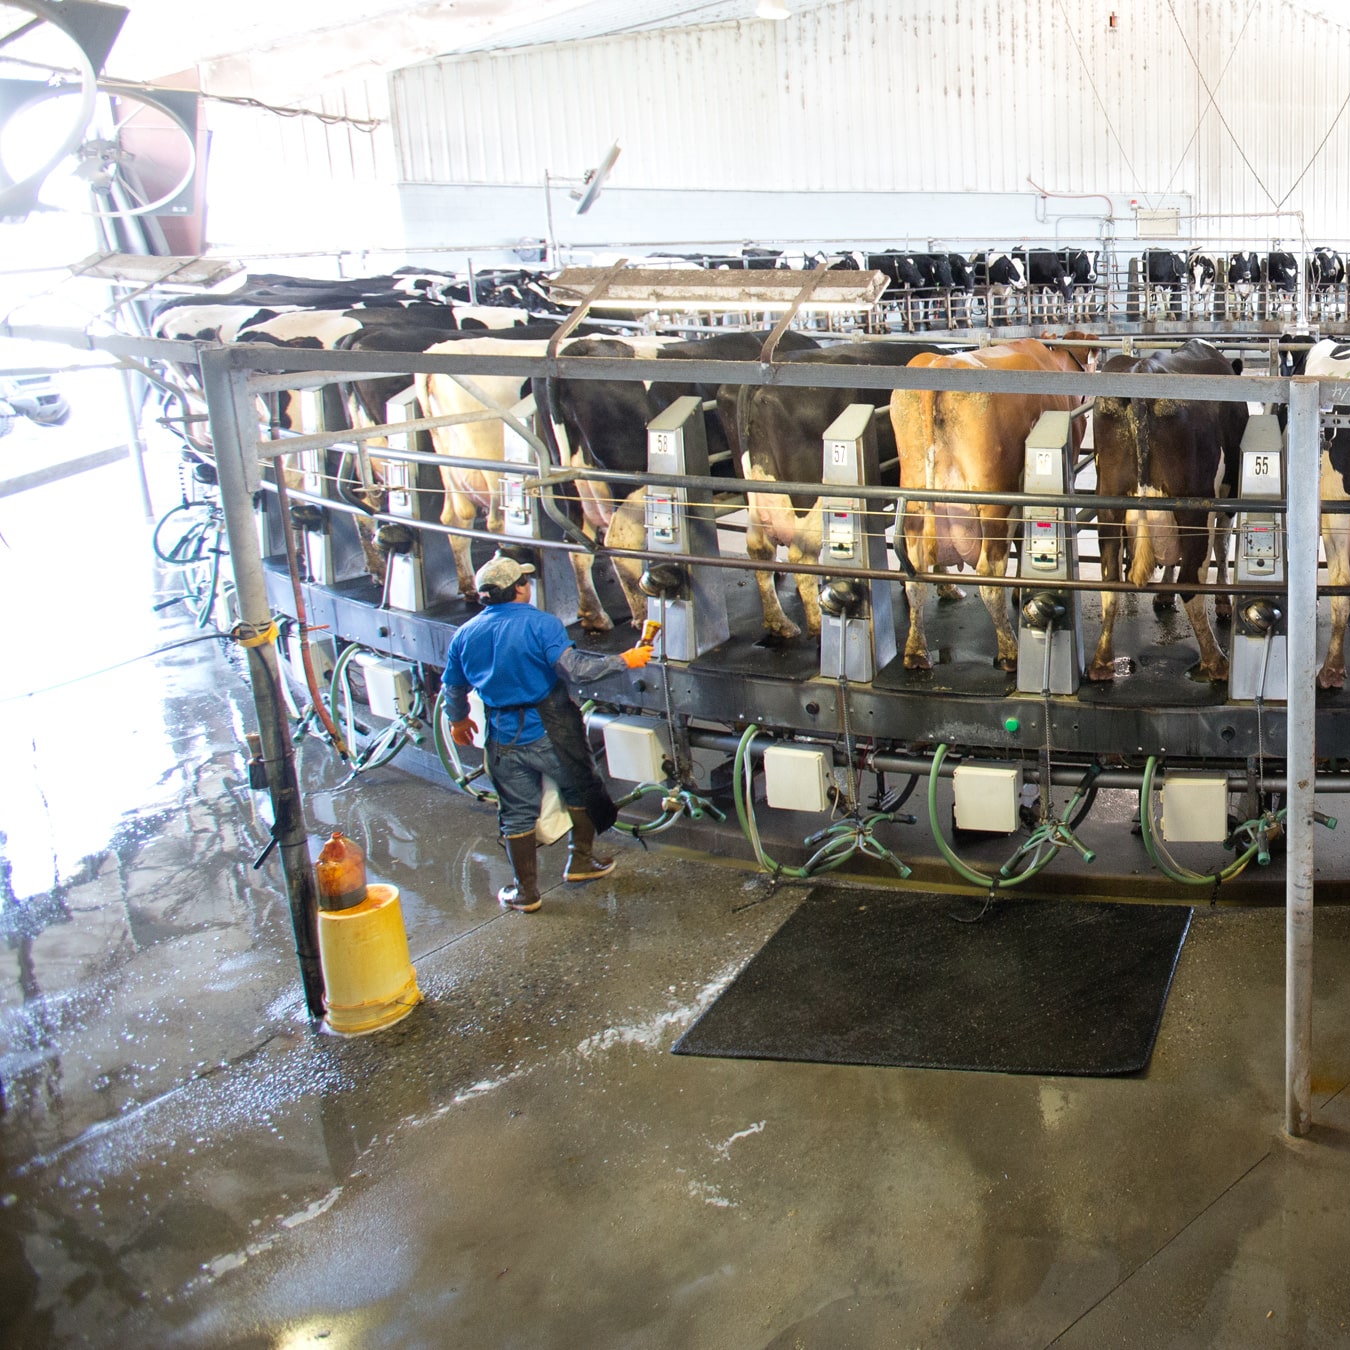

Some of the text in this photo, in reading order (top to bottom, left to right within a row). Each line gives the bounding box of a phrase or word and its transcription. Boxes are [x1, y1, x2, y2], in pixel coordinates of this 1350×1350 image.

[657, 434, 668, 453] 58
[834, 445, 846, 463] 57
[1255, 456, 1269, 475] 55
